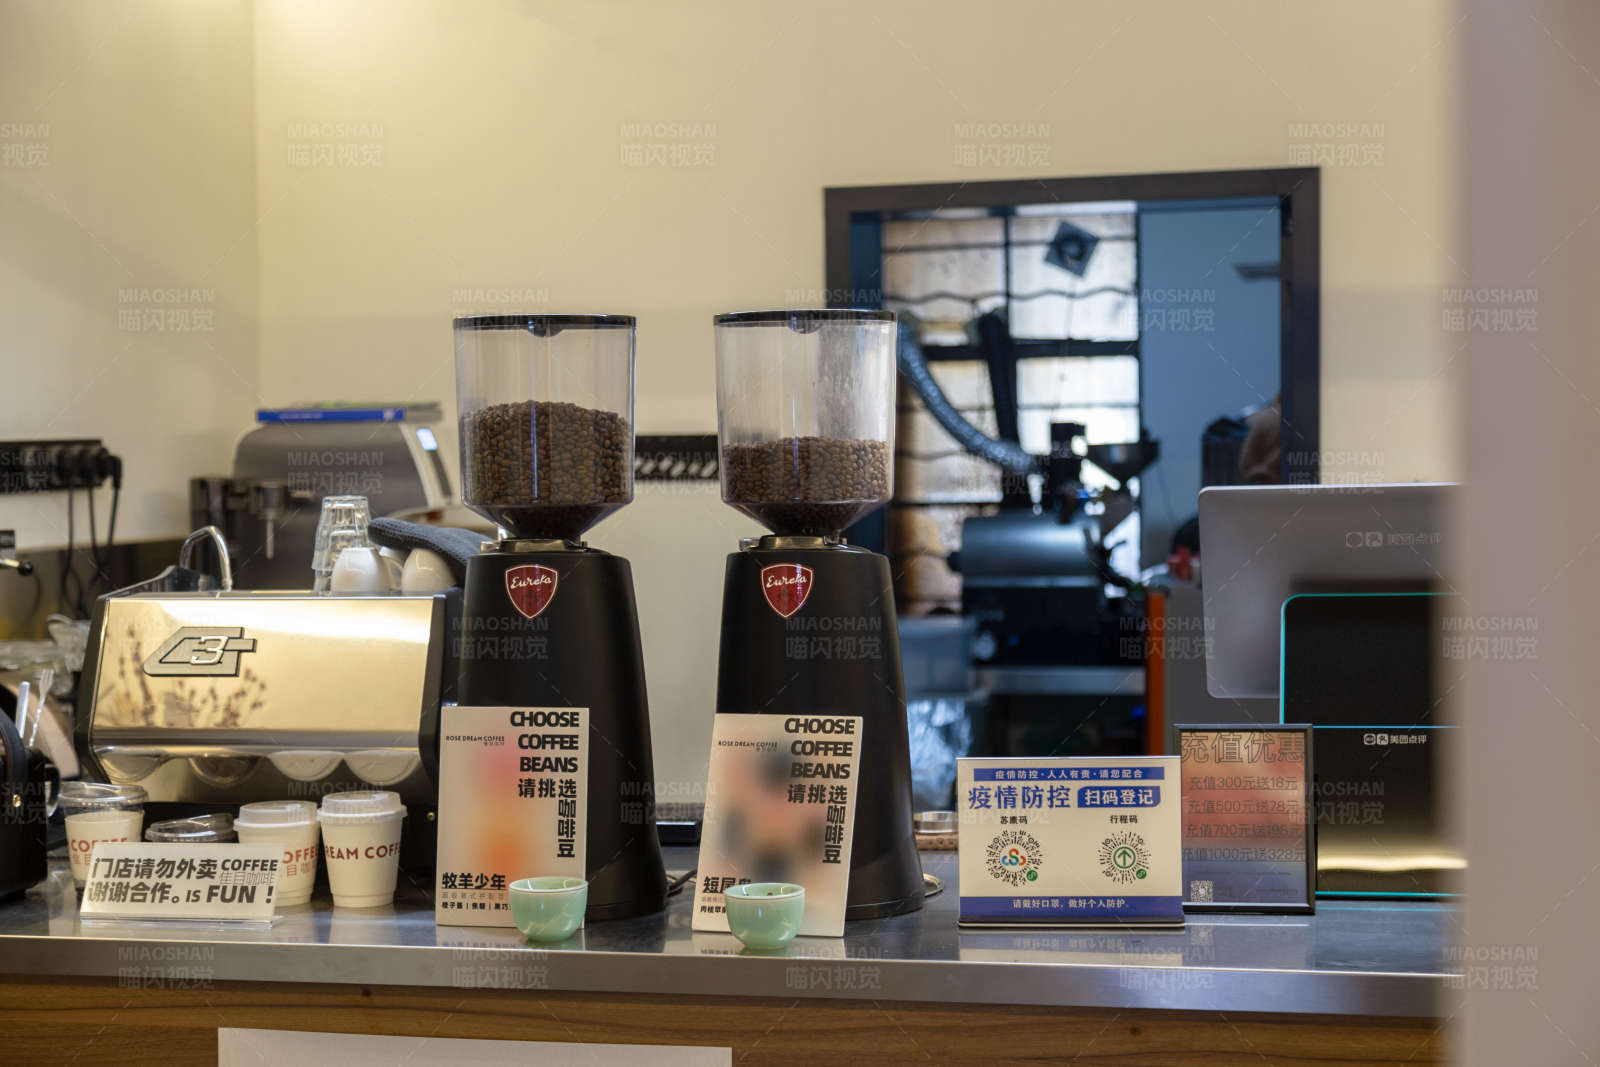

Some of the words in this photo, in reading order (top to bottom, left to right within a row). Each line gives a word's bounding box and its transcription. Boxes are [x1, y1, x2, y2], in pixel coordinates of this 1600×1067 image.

[510, 576, 552, 589] Eureka
[766, 575, 808, 588] Eureka
[510, 711, 580, 728] CHOOSE
[784, 718, 856, 735] CHOOSE
[518, 734, 580, 750] COFFEE
[790, 740, 853, 757] COFFEE
[1181, 731, 1304, 764] 充值优惠
[519, 756, 578, 773] BEANS
[791, 762, 850, 779] BEANS
[995, 768, 1144, 780] 疫情防控·人人有责·请您配合
[518, 778, 577, 798] 请挑选
[787, 784, 847, 805] 请挑选
[968, 785, 1071, 810] 疫情防控
[1084, 788, 1154, 806] 扫码登记
[557, 799, 576, 858] 咖啡豆
[1000, 815, 1028, 825] 苏康码
[1110, 815, 1138, 825] 行程码
[822, 805, 846, 864] 咖啡豆
[92, 857, 218, 880] 门店请勿外卖
[221, 859, 279, 872] COFFEE
[441, 872, 507, 890] 牧羊少年
[88, 881, 180, 905] 谢谢合作。
[184, 889, 201, 904] IS
[206, 885, 256, 905] FUN
